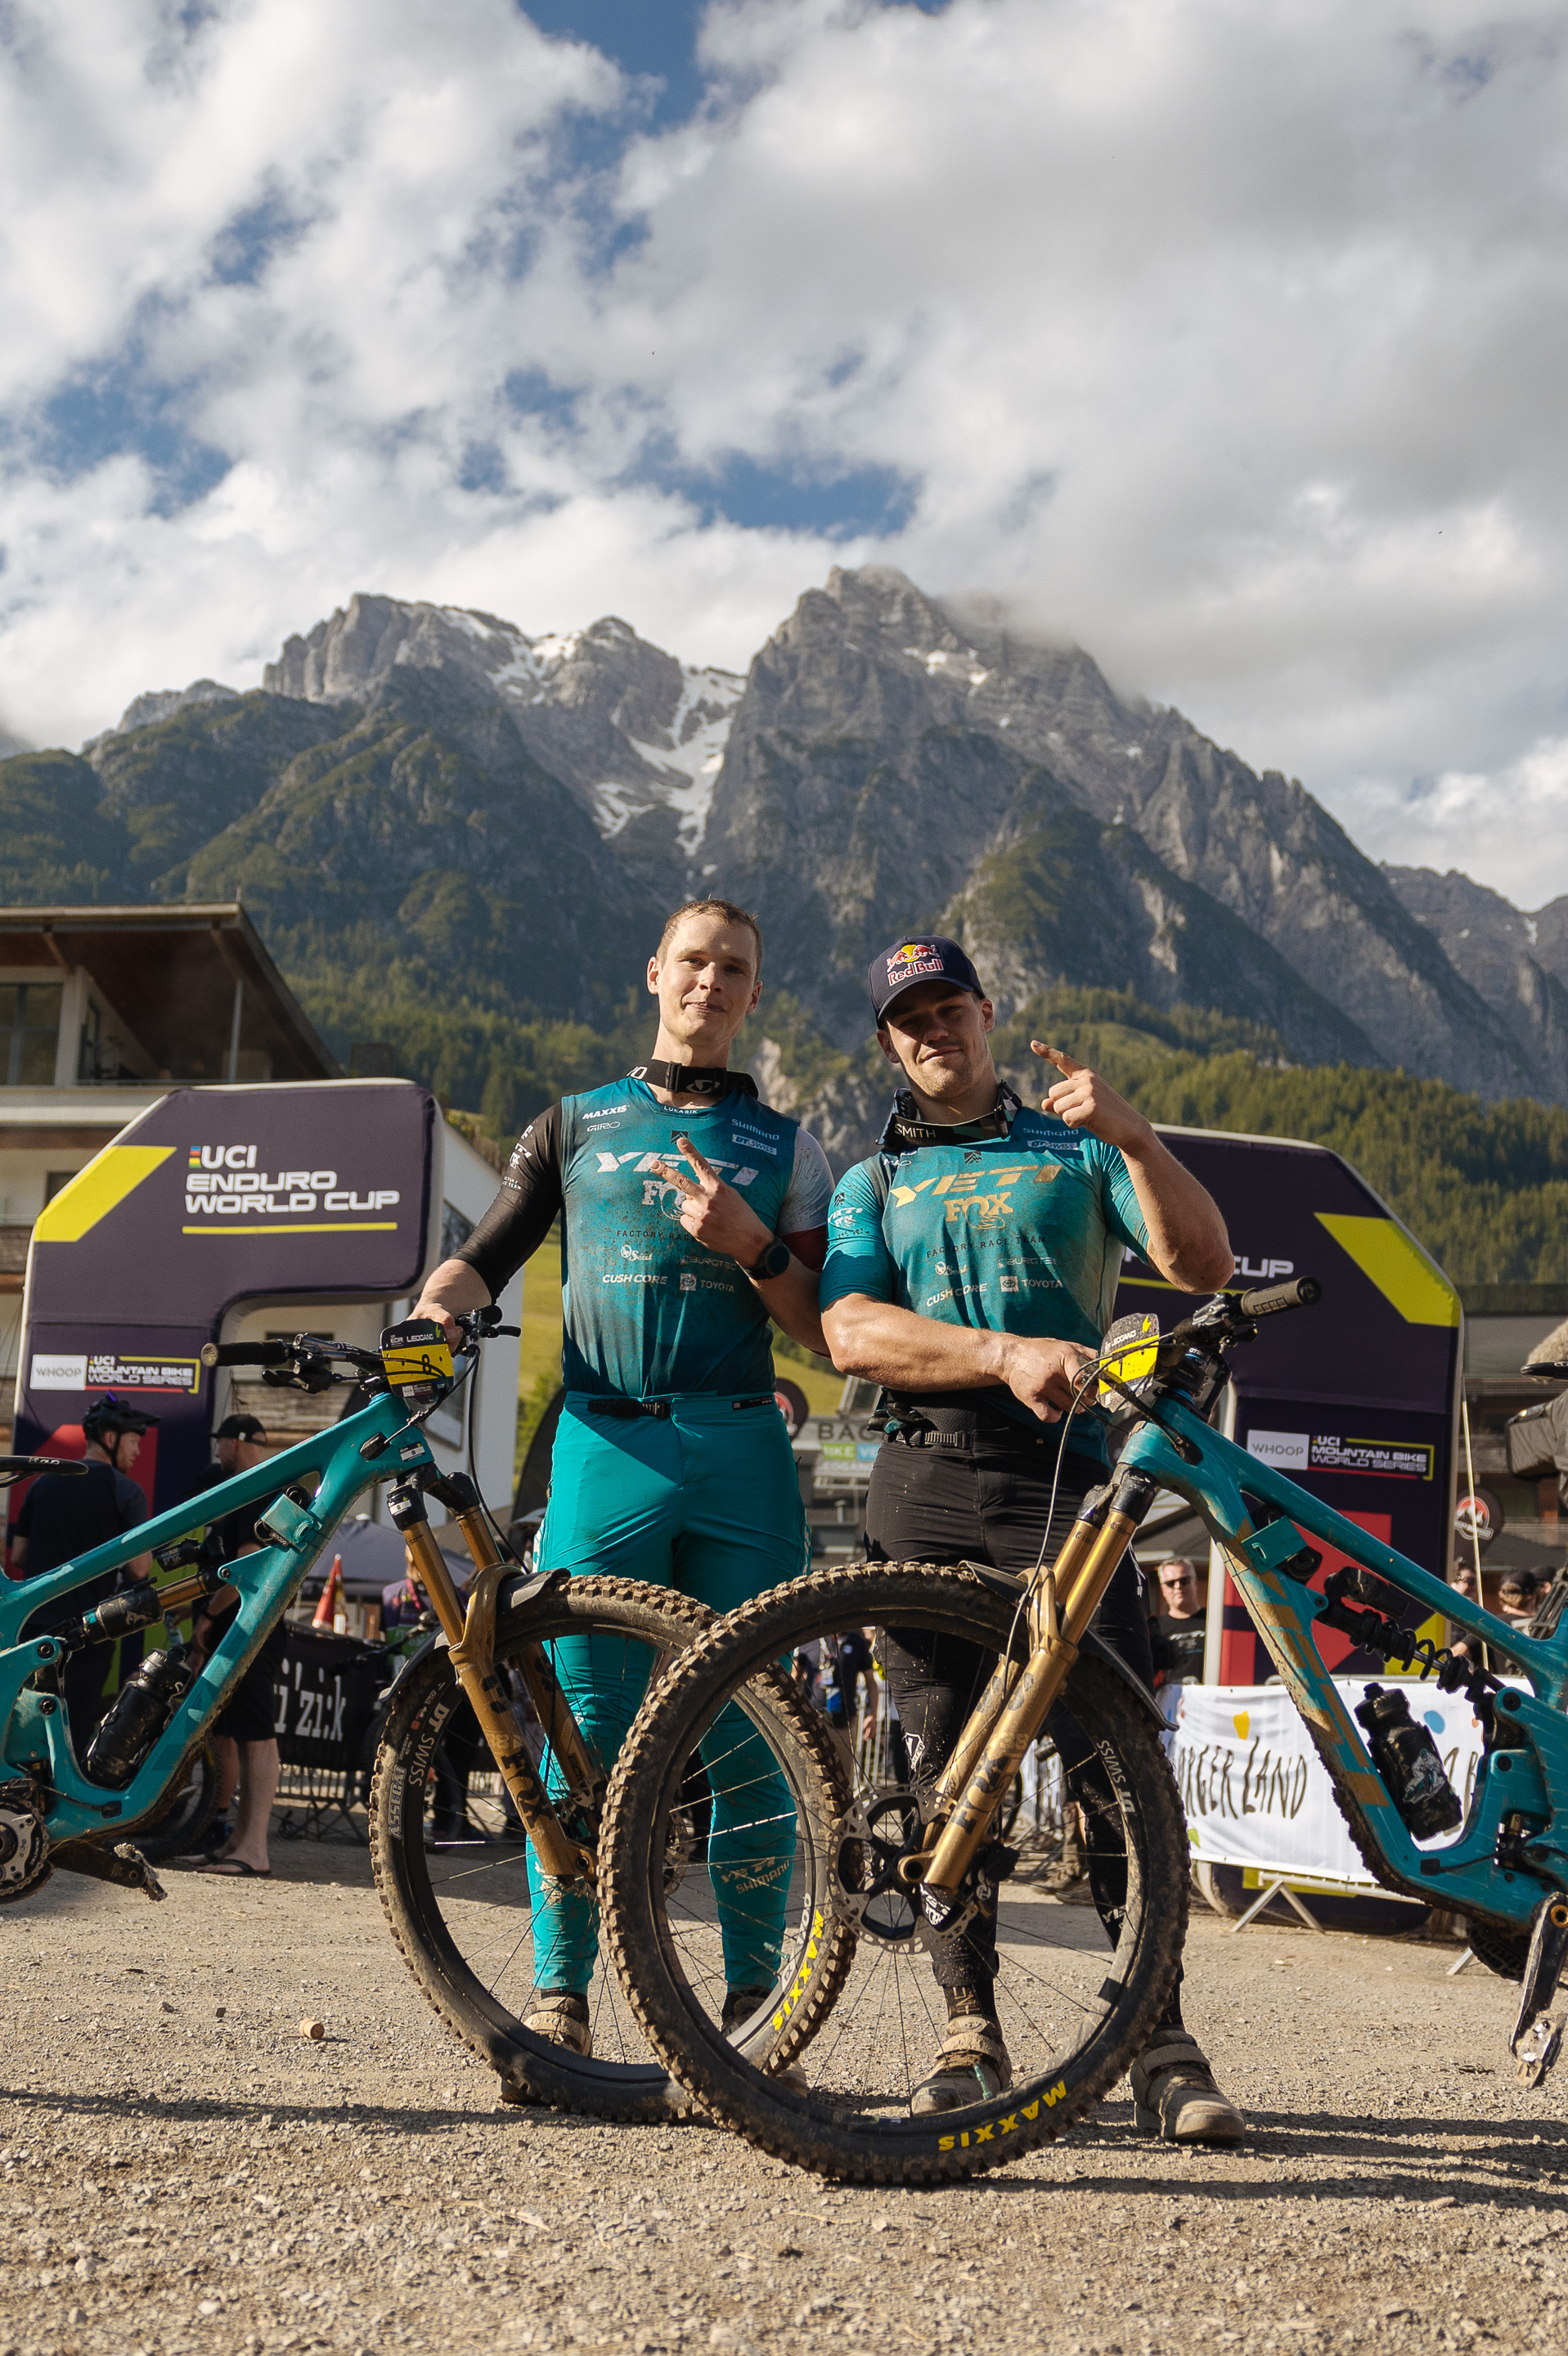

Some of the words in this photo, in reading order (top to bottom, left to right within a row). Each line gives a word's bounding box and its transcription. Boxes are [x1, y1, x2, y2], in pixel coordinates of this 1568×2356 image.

[887, 962, 915, 987] Red
[914, 959, 944, 974] Bull
[582, 1105, 627, 1120] MAXXIS
[663, 1106, 698, 1114] LUKASIK
[586, 1121, 621, 1132] GIRO
[731, 1118, 780, 1140] SHIMANO
[895, 1123, 936, 1139] SMITH
[751, 1140, 775, 1153] SWISS
[201, 1144, 257, 1169] UCI
[186, 1171, 337, 1193] ENDURO
[890, 1164, 1063, 1208] YETI
[185, 1192, 317, 1214] WORLD
[324, 1190, 400, 1211] CUP
[944, 1191, 1014, 1230] FOX
[617, 1230, 663, 1239] FACTORY
[927, 1243, 973, 1258] FACTORY
[980, 1238, 1009, 1248] RACE
[690, 1257, 736, 1270] BURGTEC
[602, 1274, 631, 1284] CUSH
[633, 1274, 668, 1285] CORE
[700, 1279, 735, 1293] TOYOTA
[1022, 1279, 1063, 1289] TOYOTA
[927, 1288, 954, 1307] CUSH
[955, 1283, 988, 1296] CORE
[407, 1333, 434, 1342] LEOGANG
[93, 1356, 115, 1365] UCI
[36, 1367, 81, 1378] WHOOP
[88, 1365, 159, 1376] MOUNTAIN
[161, 1367, 193, 1377] BIKE
[88, 1374, 140, 1384] WORLD
[142, 1376, 193, 1386] SERIES
[1252, 1442, 1305, 1456] WHOOP
[1317, 1436, 1341, 1446] UCI
[1311, 1446, 1390, 1460] MOUNTAIN
[1392, 1452, 1426, 1463] BIKE
[1311, 1455, 1369, 1468] WORLD
[1372, 1459, 1426, 1472] SERIES
[428, 1702, 450, 1733] DT
[408, 1733, 434, 1787] SWISS
[1096, 1739, 1126, 1783] SWISS
[1242, 1735, 1307, 1820] LAND
[388, 1764, 407, 1840] ASSEGAI
[1117, 1788, 1135, 1813] DT
[736, 1860, 790, 1894] SHIMANO
[772, 1909, 824, 2030] MAXXIS
[938, 2080, 1067, 2151] MAXXIS
